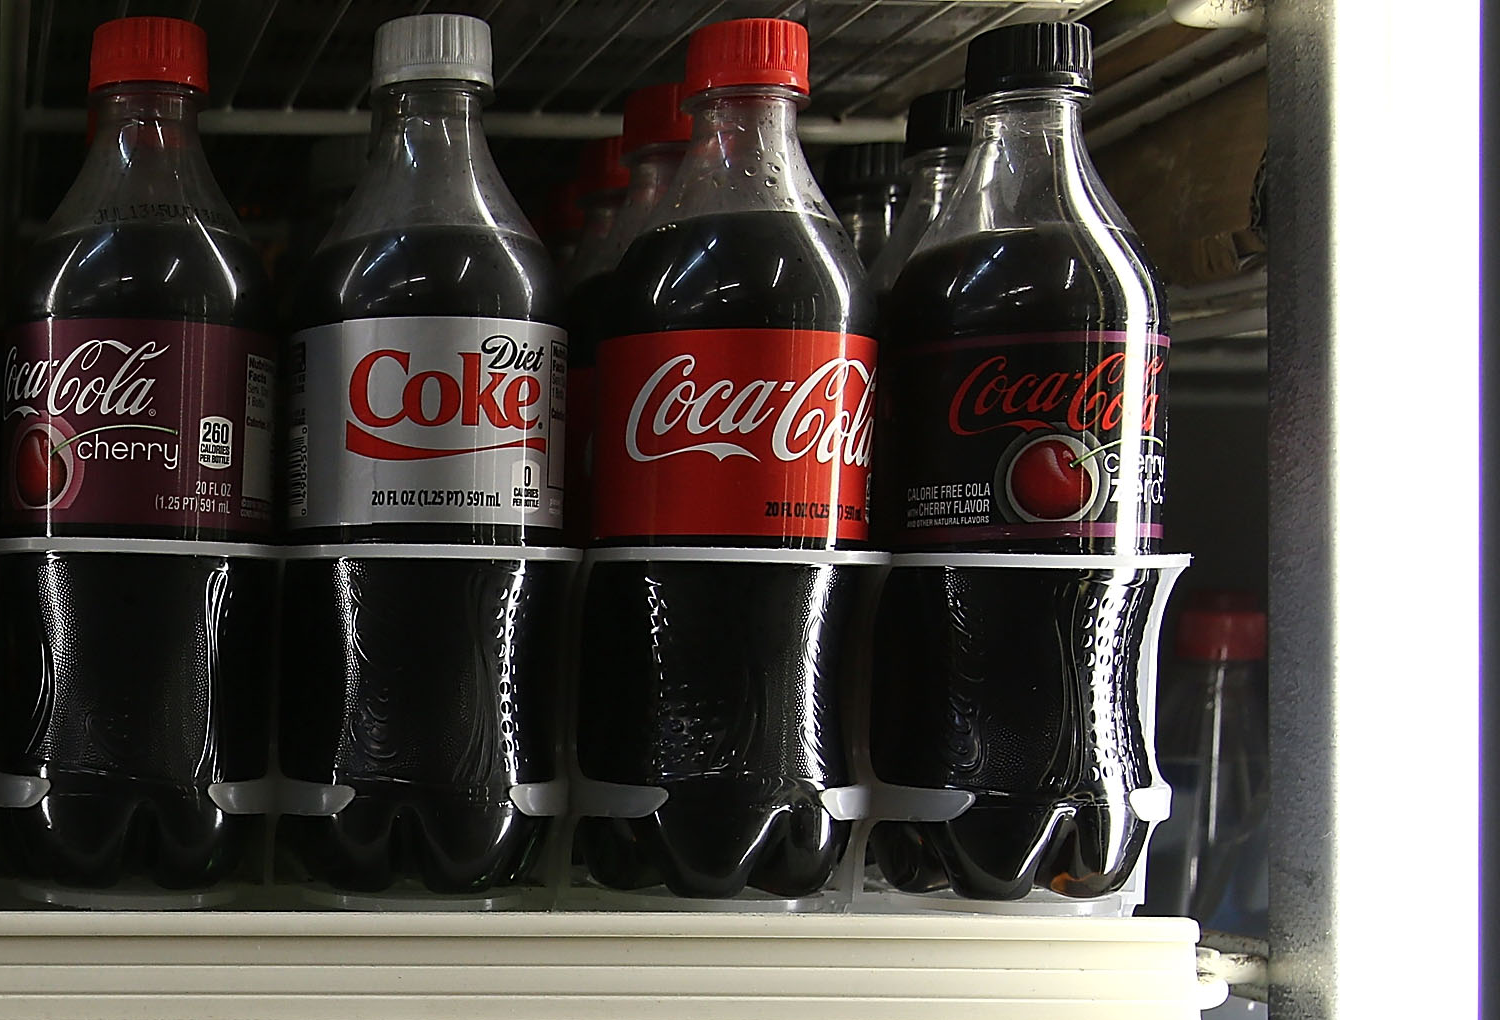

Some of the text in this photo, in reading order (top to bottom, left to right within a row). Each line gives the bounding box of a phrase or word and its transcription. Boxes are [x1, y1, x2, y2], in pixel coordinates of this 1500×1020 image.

[480, 334, 544, 373] Diet
[3, 339, 171, 421] Coca-Cola
[348, 349, 541, 430] Coke
[625, 353, 876, 469] Coca-Cola
[202, 422, 230, 444] 260
[76, 433, 180, 470] cherry
[200, 444, 230, 456] CALORIES
[200, 454, 230, 465] PER BOTTLE
[524, 466, 532, 487] 0
[195, 480, 232, 498] 20 FL OZ
[907, 482, 991, 502] CALORIE FREE COLA
[154, 496, 231, 514] (1.25 PT) 591 mL
[371, 490, 501, 508] 20 FL OZ (1.25 PT) 591 mL
[918, 498, 990, 517] CHERRY FLAVOR
[764, 501, 808, 518] 20 FL OZ
[934, 516, 990, 526] NATURAL FLAVORS
